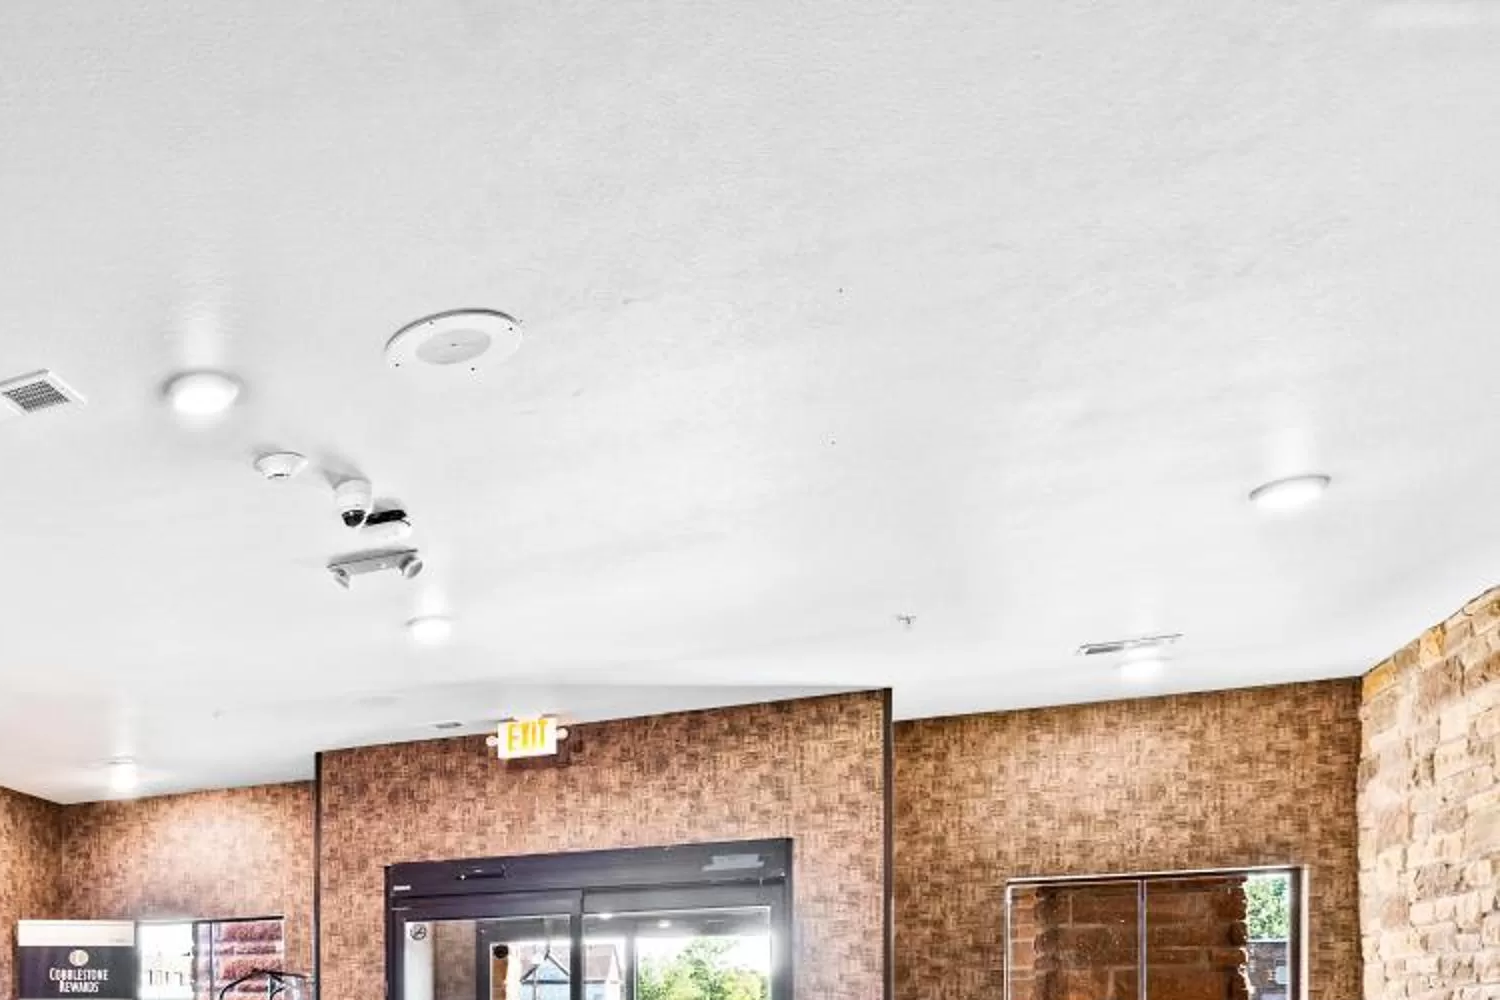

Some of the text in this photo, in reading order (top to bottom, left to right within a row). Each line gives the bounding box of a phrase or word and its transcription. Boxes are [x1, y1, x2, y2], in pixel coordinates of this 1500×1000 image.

[507, 719, 548, 752] EXIT
[49, 967, 108, 980] COBBLESTONE
[60, 980, 99, 992] REWARDS
